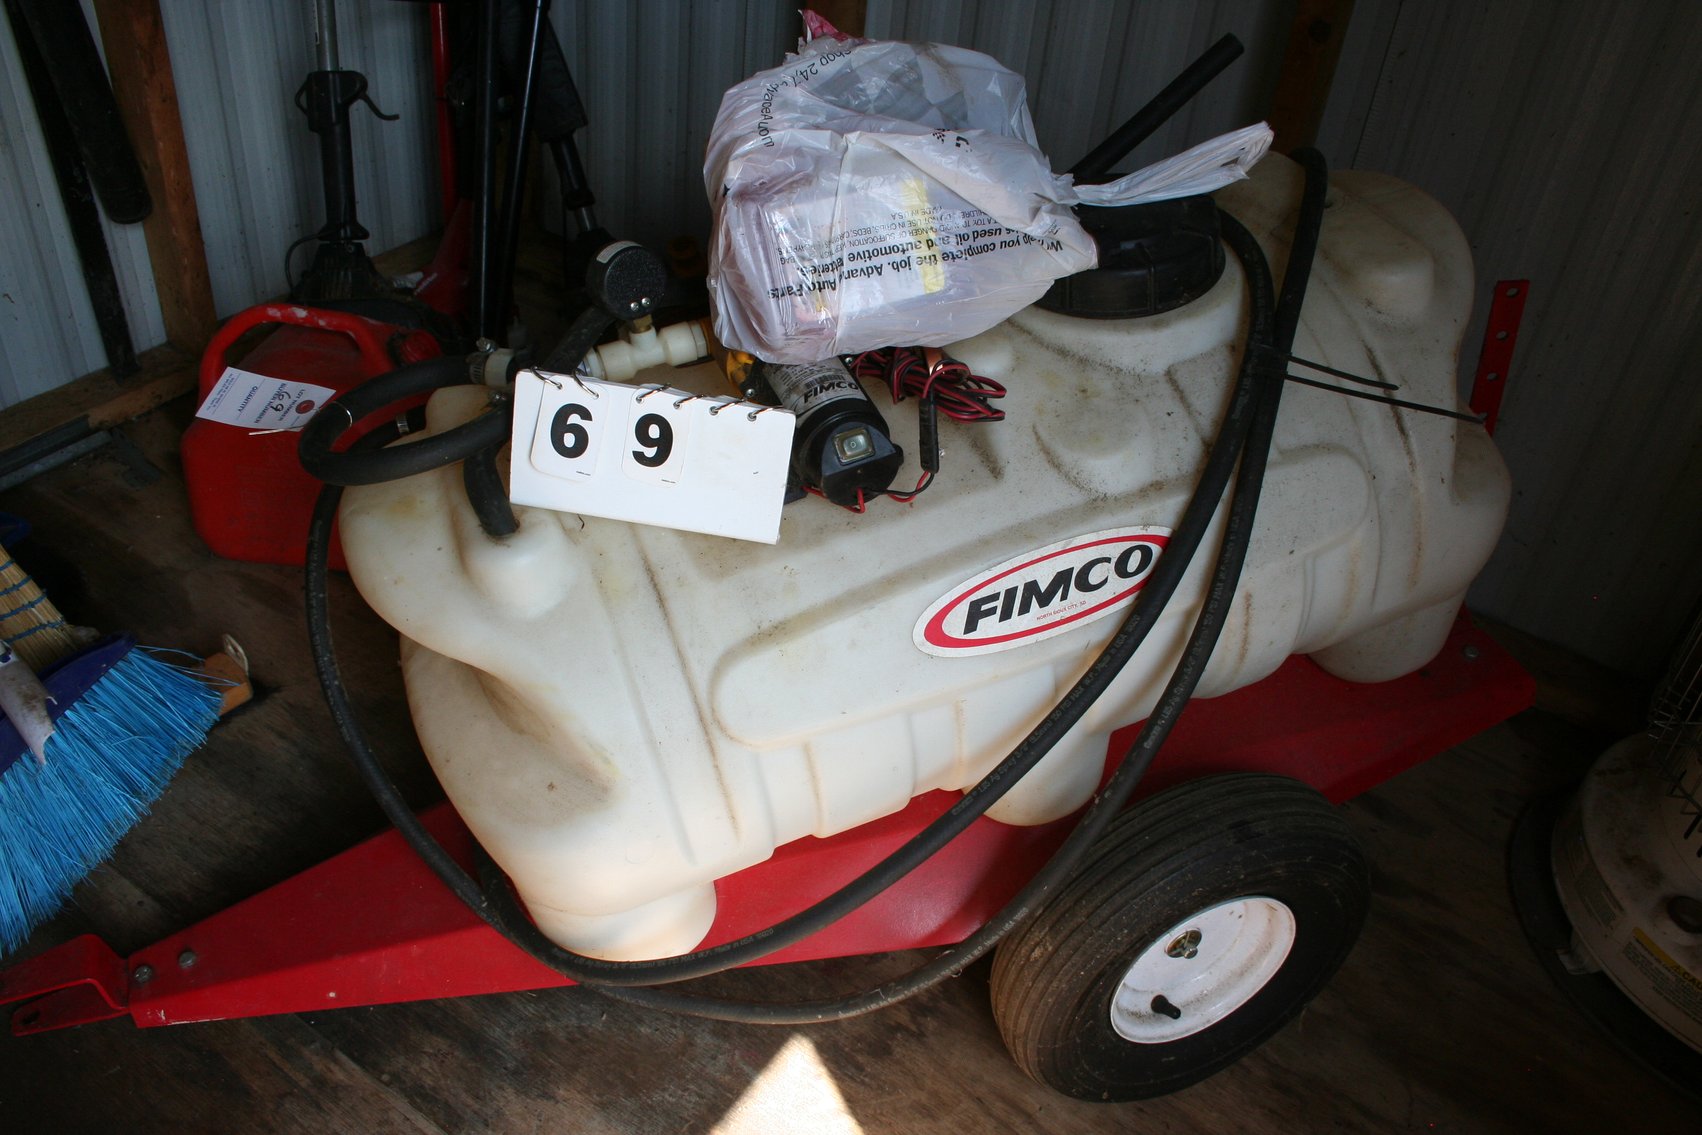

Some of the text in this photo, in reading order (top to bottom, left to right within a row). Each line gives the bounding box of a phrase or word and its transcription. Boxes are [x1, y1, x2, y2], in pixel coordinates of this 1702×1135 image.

[847, 234, 895, 247] SUFFOCATION,
[851, 227, 871, 236] BEDS,
[955, 233, 970, 246] oil
[972, 227, 1002, 242] used
[942, 241, 996, 263] complete
[1000, 236, 1021, 250] you
[847, 242, 922, 263] automotive
[914, 253, 938, 269] the
[886, 256, 913, 274] job.
[767, 283, 804, 301] Parts
[809, 279, 836, 293] Auto
[237, 384, 258, 413] QUANTITY
[803, 380, 859, 403] FIMCO
[271, 390, 290, 412] 69
[550, 403, 673, 467] 6 9
[963, 544, 1154, 635] FIMCO
[1036, 612, 1053, 621] NORTH
